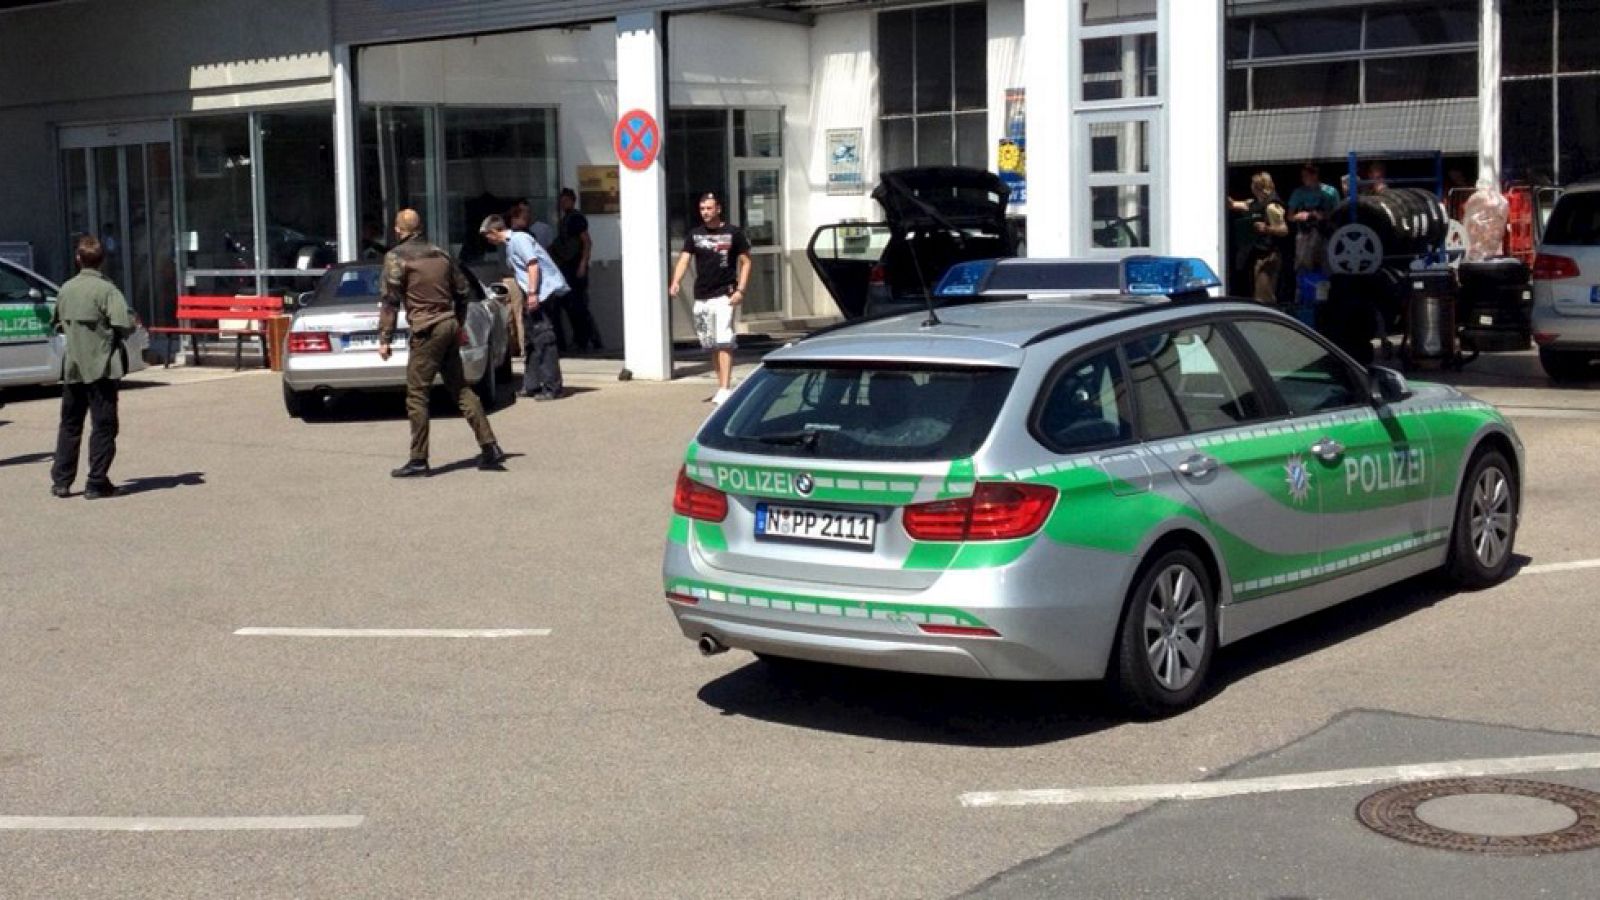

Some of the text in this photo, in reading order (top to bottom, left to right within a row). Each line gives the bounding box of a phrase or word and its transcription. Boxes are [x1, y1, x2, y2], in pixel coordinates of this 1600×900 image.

[717, 466, 794, 494] POLIZEI
[1344, 448, 1424, 495] POLIZEI
[820, 513, 870, 540] 2111
